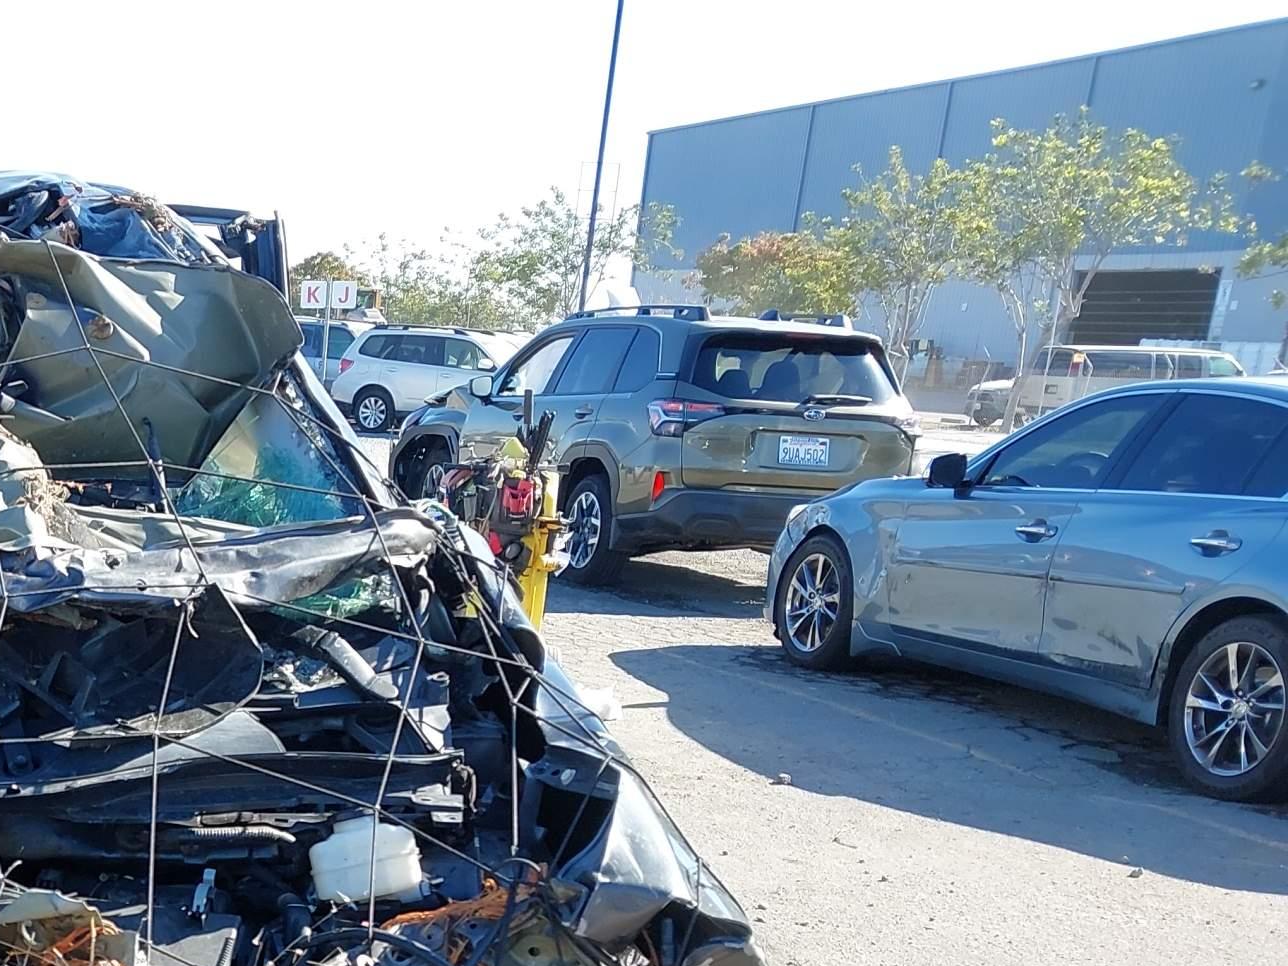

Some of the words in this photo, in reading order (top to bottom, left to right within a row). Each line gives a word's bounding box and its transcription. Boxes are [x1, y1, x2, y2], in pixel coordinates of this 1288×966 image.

[307, 286, 320, 303] K
[338, 286, 349, 303] J
[782, 447, 825, 462] 9UAJ502
